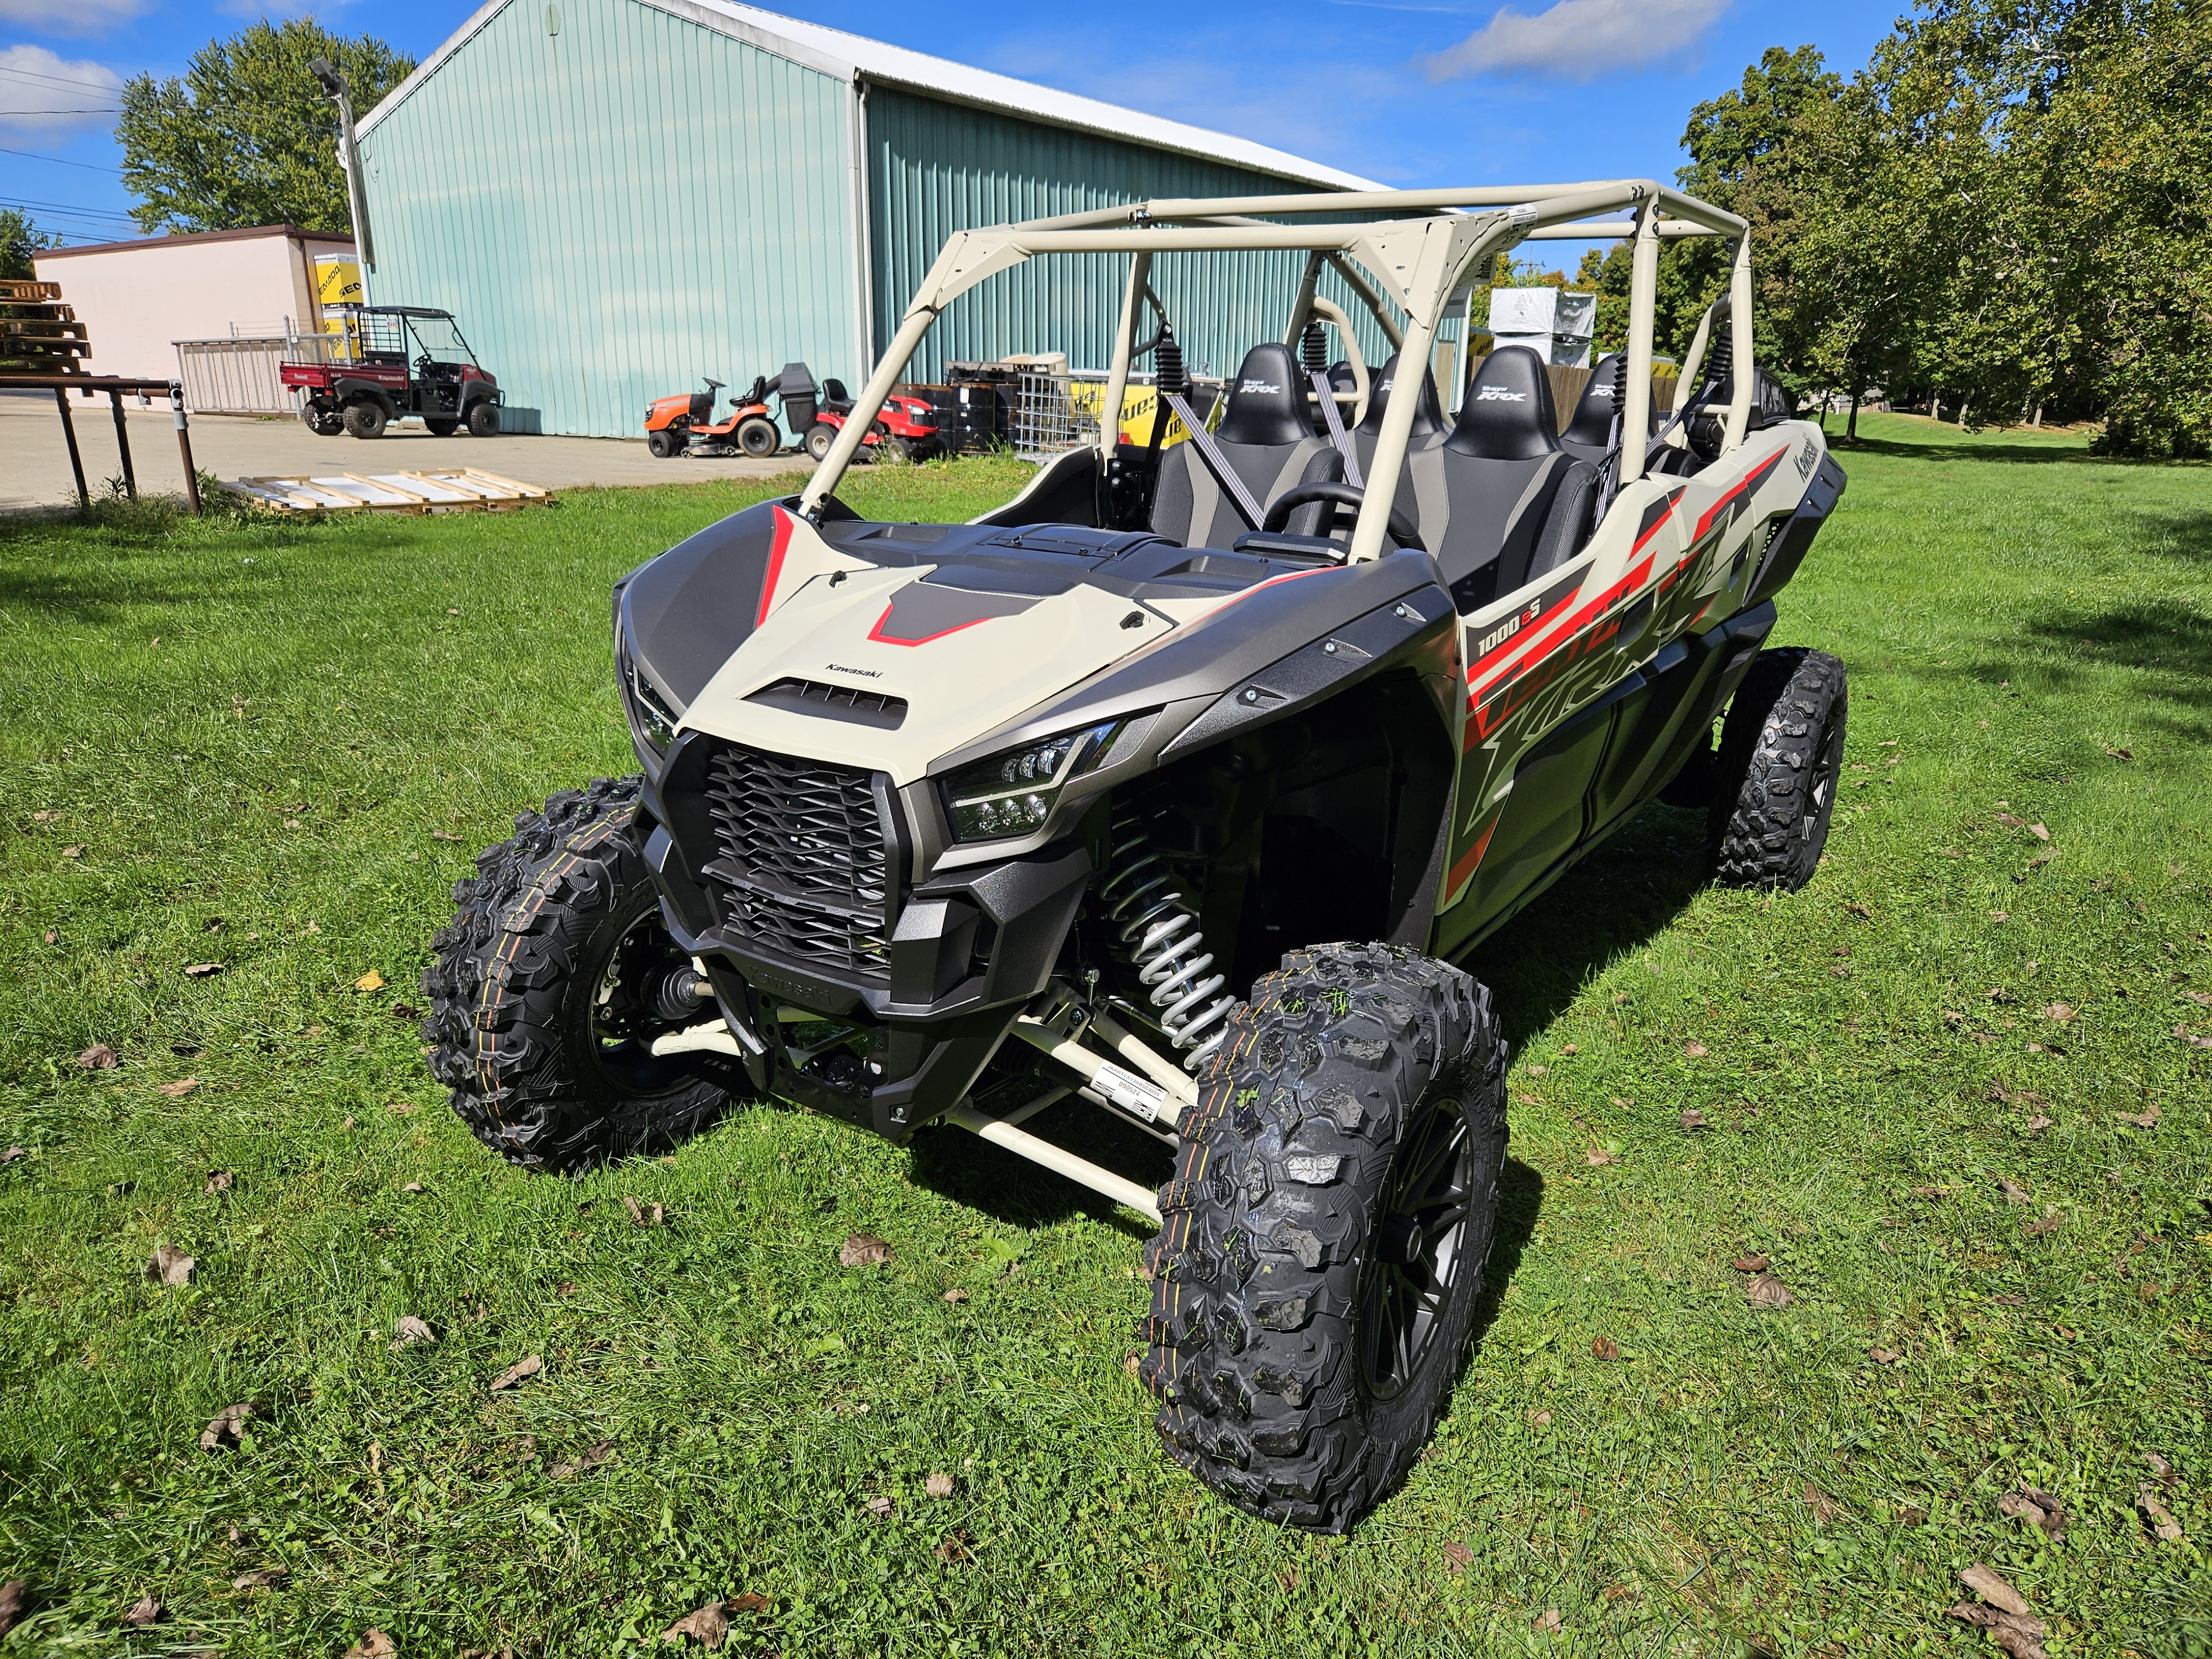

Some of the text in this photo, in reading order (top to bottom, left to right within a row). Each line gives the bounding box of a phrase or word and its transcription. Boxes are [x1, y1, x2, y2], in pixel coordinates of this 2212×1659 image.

[1239, 385, 1281, 394] KRX
[1477, 392, 1527, 401] KRX
[1793, 432, 1819, 484] Kawasaki
[1478, 615, 1520, 657] 1000
[825, 664, 884, 678] Kawasaki
[747, 964, 831, 1006] Kawasaki
[1118, 1081, 1140, 1097] 090524
